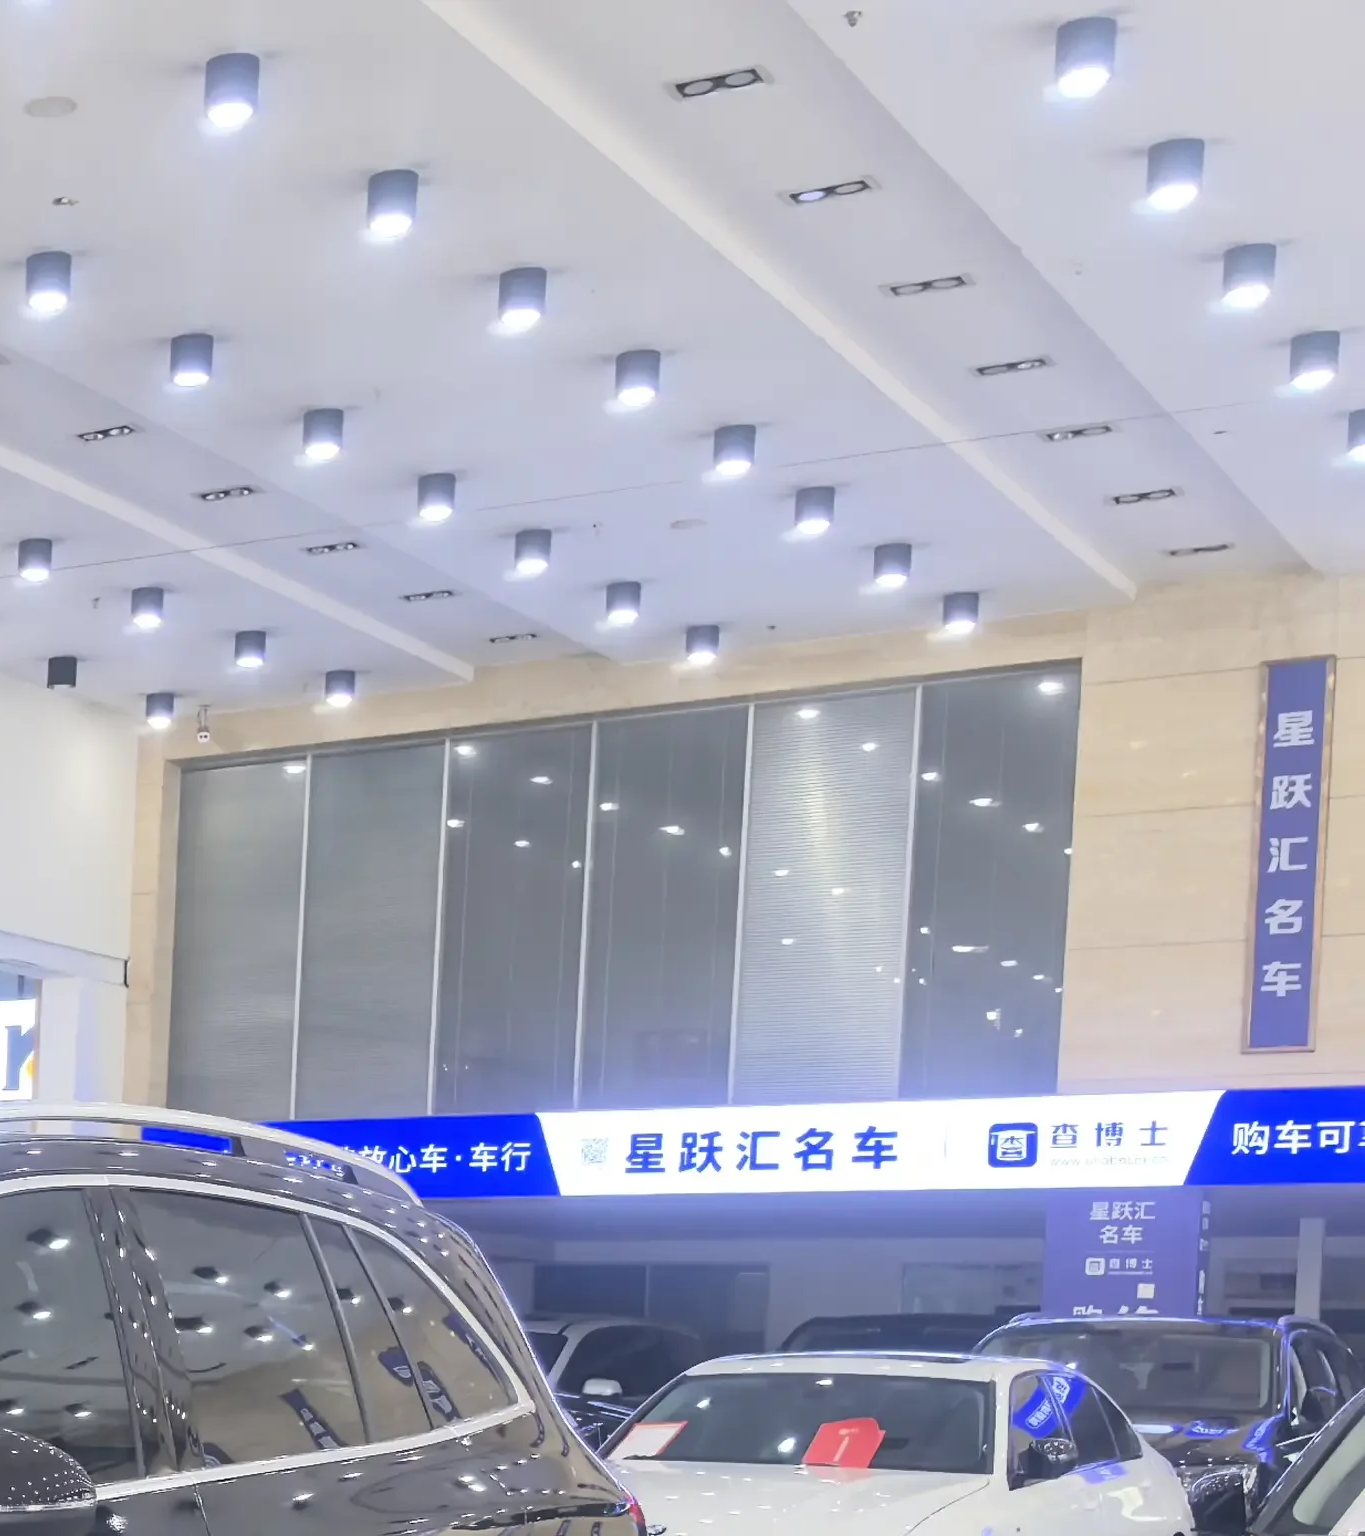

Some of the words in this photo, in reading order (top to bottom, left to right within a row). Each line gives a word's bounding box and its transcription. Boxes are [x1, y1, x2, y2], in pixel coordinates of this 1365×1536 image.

[1260, 710, 1315, 997] 星跃汇名车
[625, 1126, 899, 1174] 星跃汇名车
[1050, 1120, 1169, 1149] 查博士
[1231, 1119, 1365, 1155] 购车可
[342, 1142, 532, 1174] 放心车·车行
[1089, 1201, 1156, 1221] 星跃汇
[1099, 1224, 1143, 1244] 名车
